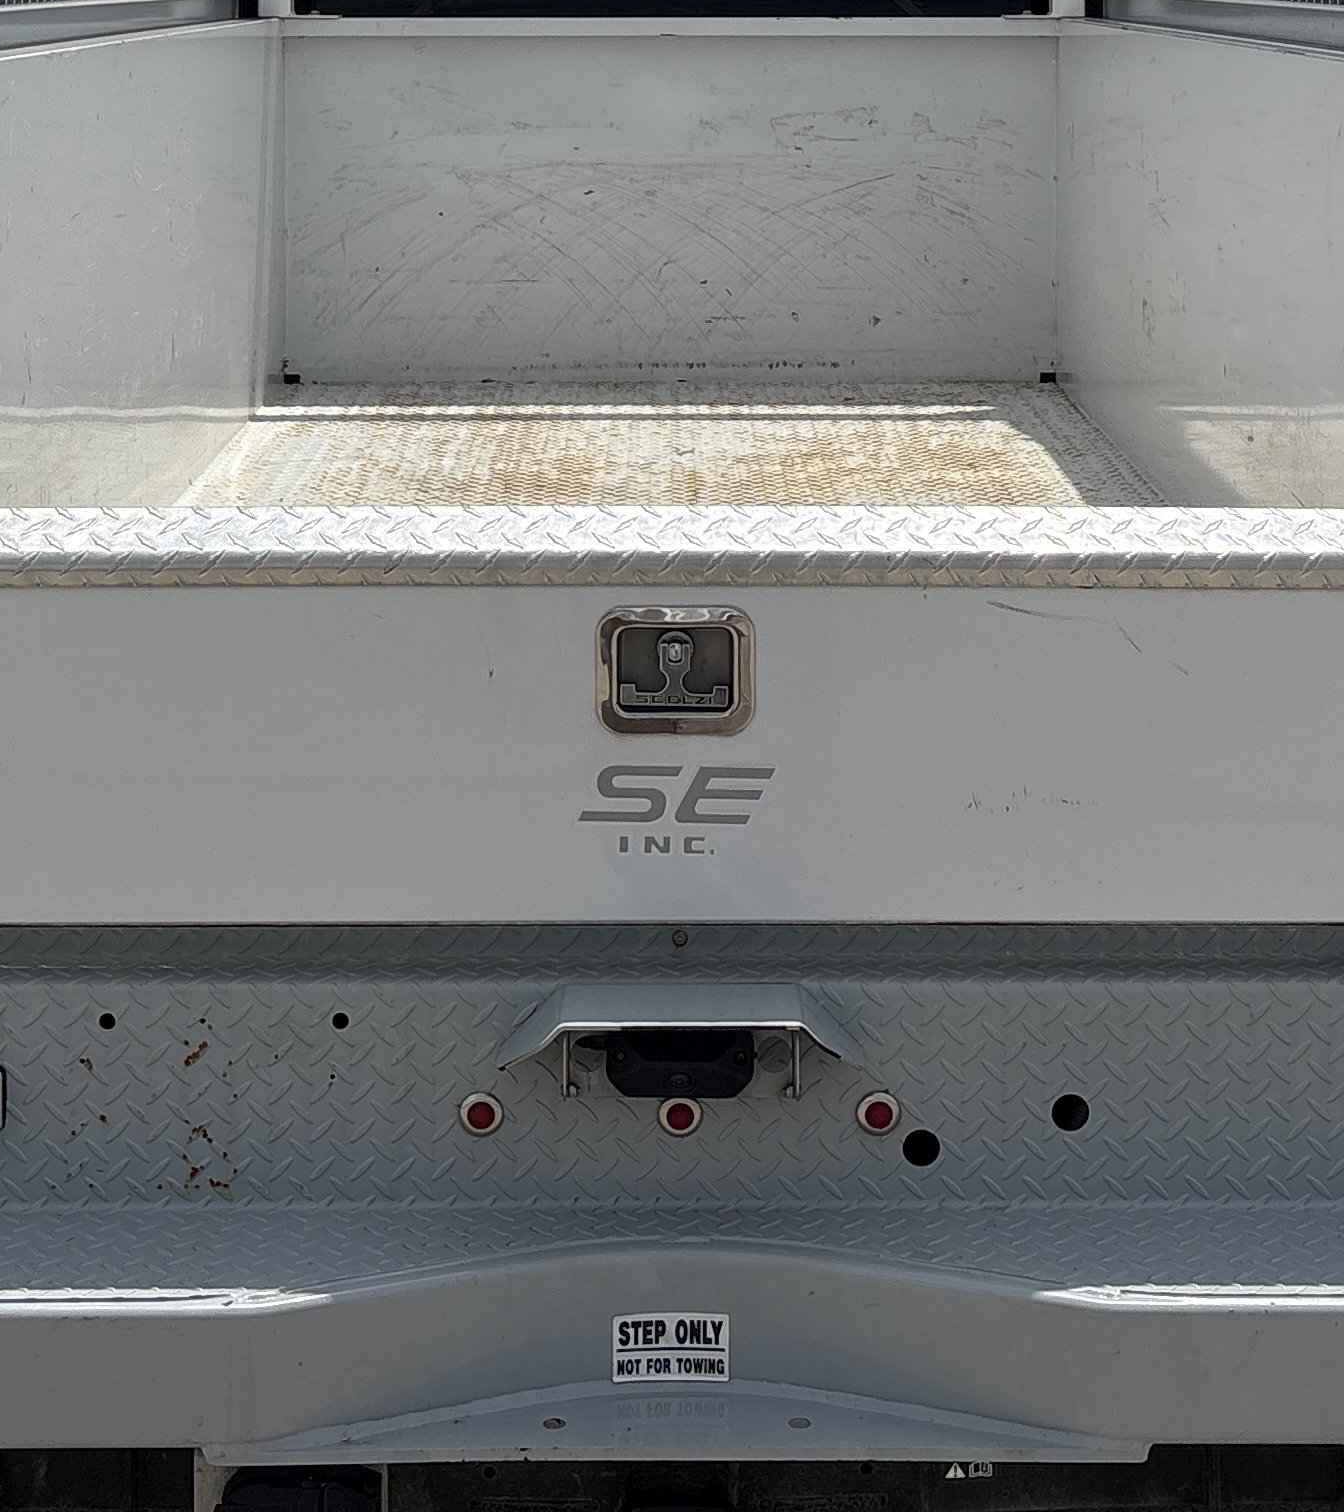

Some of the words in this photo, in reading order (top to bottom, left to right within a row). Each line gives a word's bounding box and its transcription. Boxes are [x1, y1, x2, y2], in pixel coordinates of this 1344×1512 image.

[578, 765, 776, 825] SE
[619, 836, 715, 855] INC.
[618, 1319, 667, 1347] STEP
[674, 1319, 724, 1345] ONLY
[617, 1358, 642, 1376] NOT
[646, 1358, 671, 1374] FOR
[676, 1357, 725, 1375] TOWING
